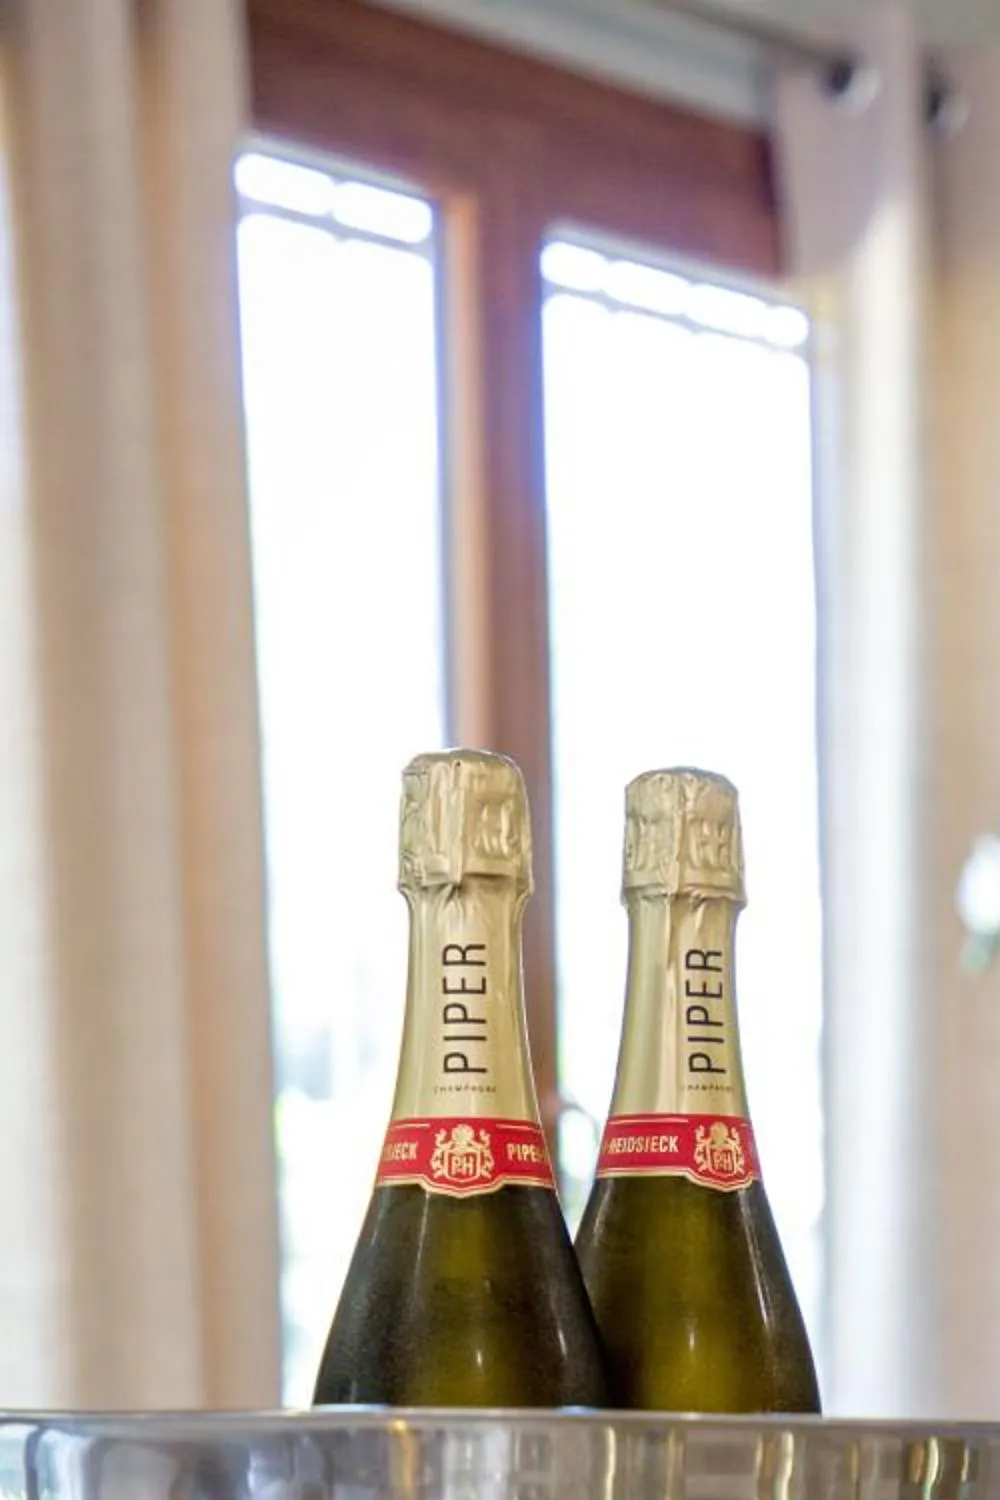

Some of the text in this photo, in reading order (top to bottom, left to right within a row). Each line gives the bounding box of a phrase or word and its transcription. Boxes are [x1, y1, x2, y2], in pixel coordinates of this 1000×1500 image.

[441, 943, 488, 1074] PIPER
[685, 948, 726, 1074] PIPER
[451, 1155, 475, 1176] PH
